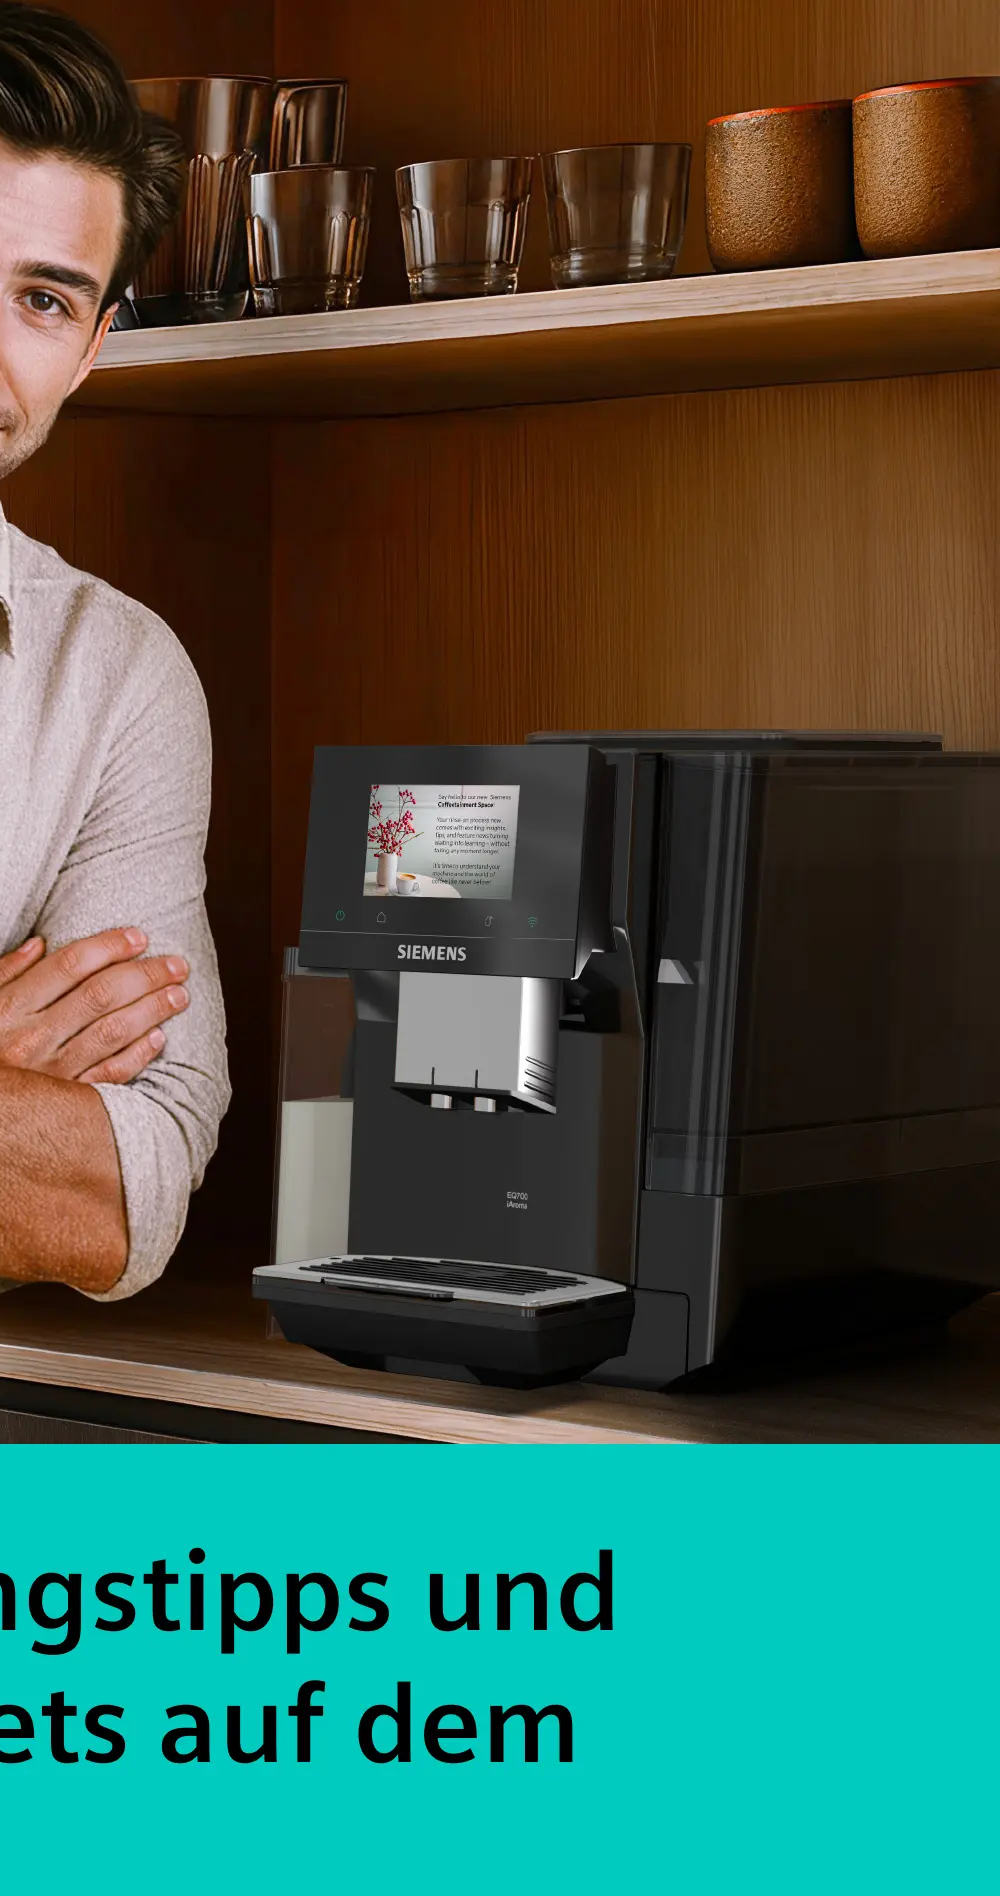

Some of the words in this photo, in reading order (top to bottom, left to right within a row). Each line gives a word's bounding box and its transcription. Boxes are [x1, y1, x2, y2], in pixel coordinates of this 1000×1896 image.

[397, 944, 467, 962] SIEMENS
[506, 1191, 528, 1200] EQ700
[506, 1200, 528, 1209] iAroma
